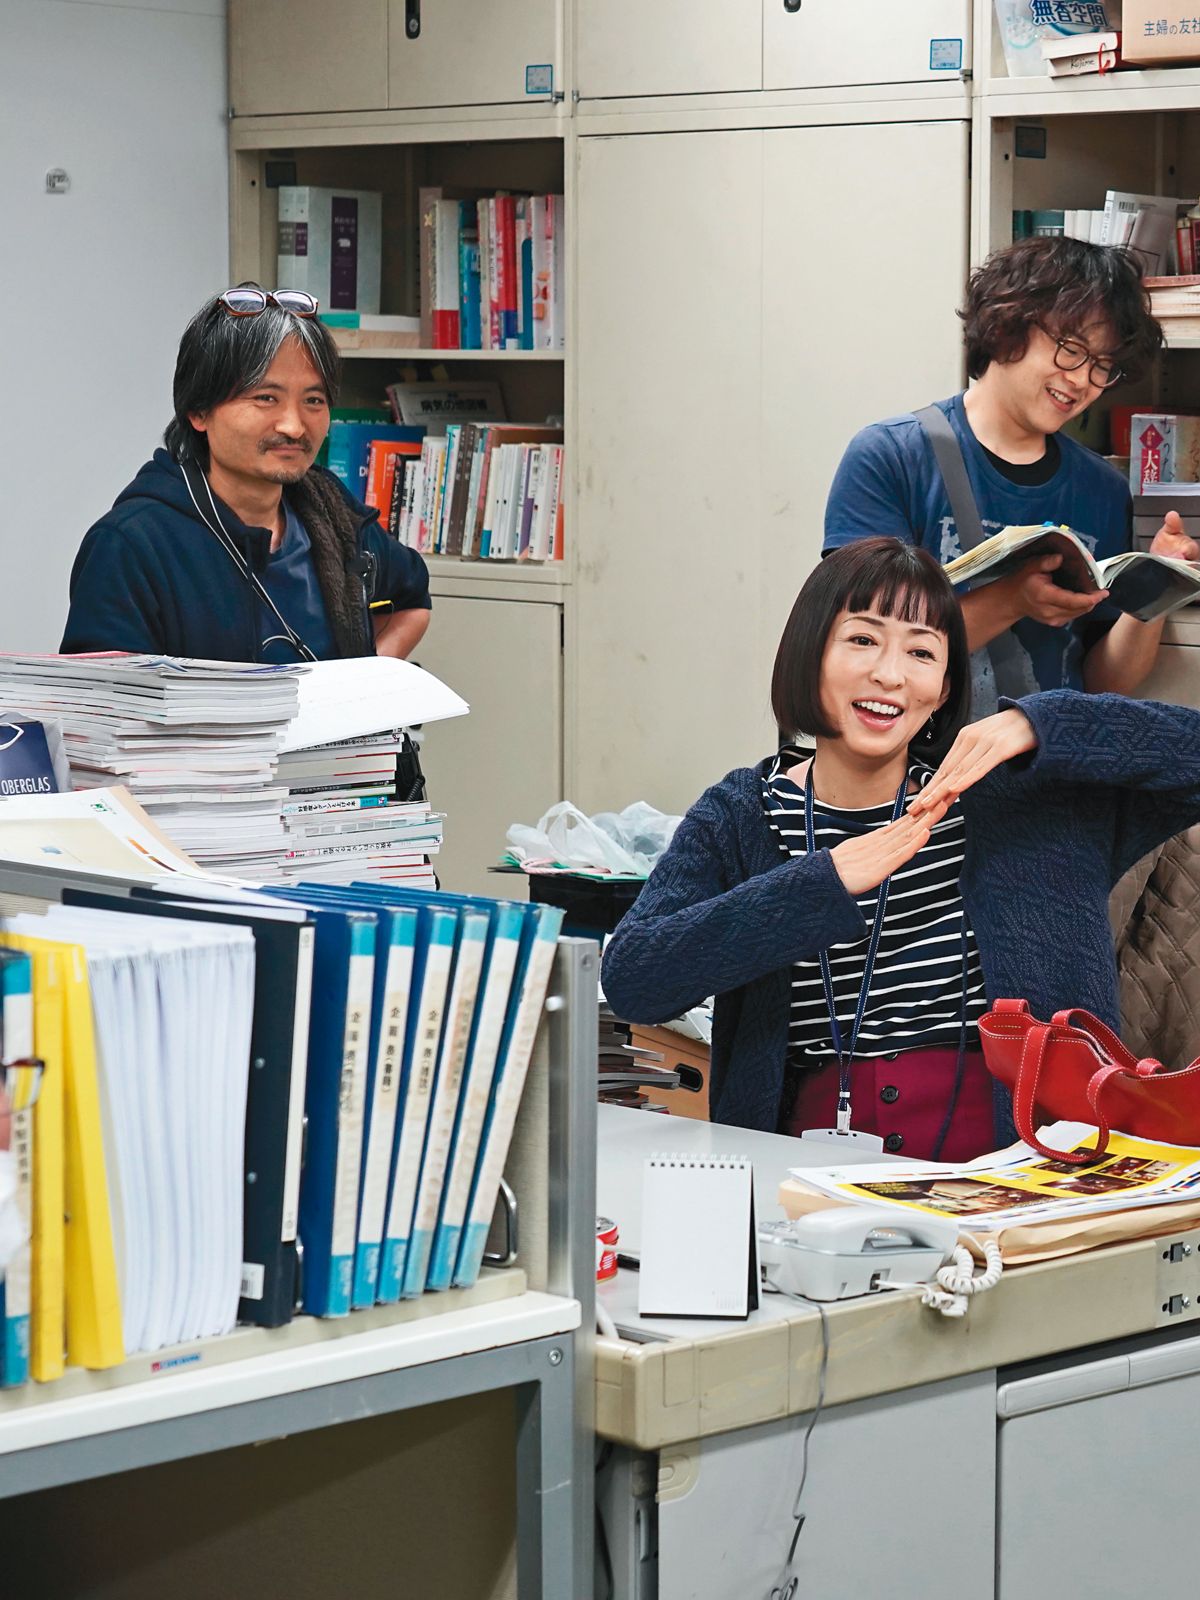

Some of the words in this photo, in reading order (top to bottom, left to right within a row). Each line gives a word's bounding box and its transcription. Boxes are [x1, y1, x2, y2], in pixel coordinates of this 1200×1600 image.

[1031, 0, 1109, 27] 無香空間
[1, 777, 51, 795] OBERGLAS
